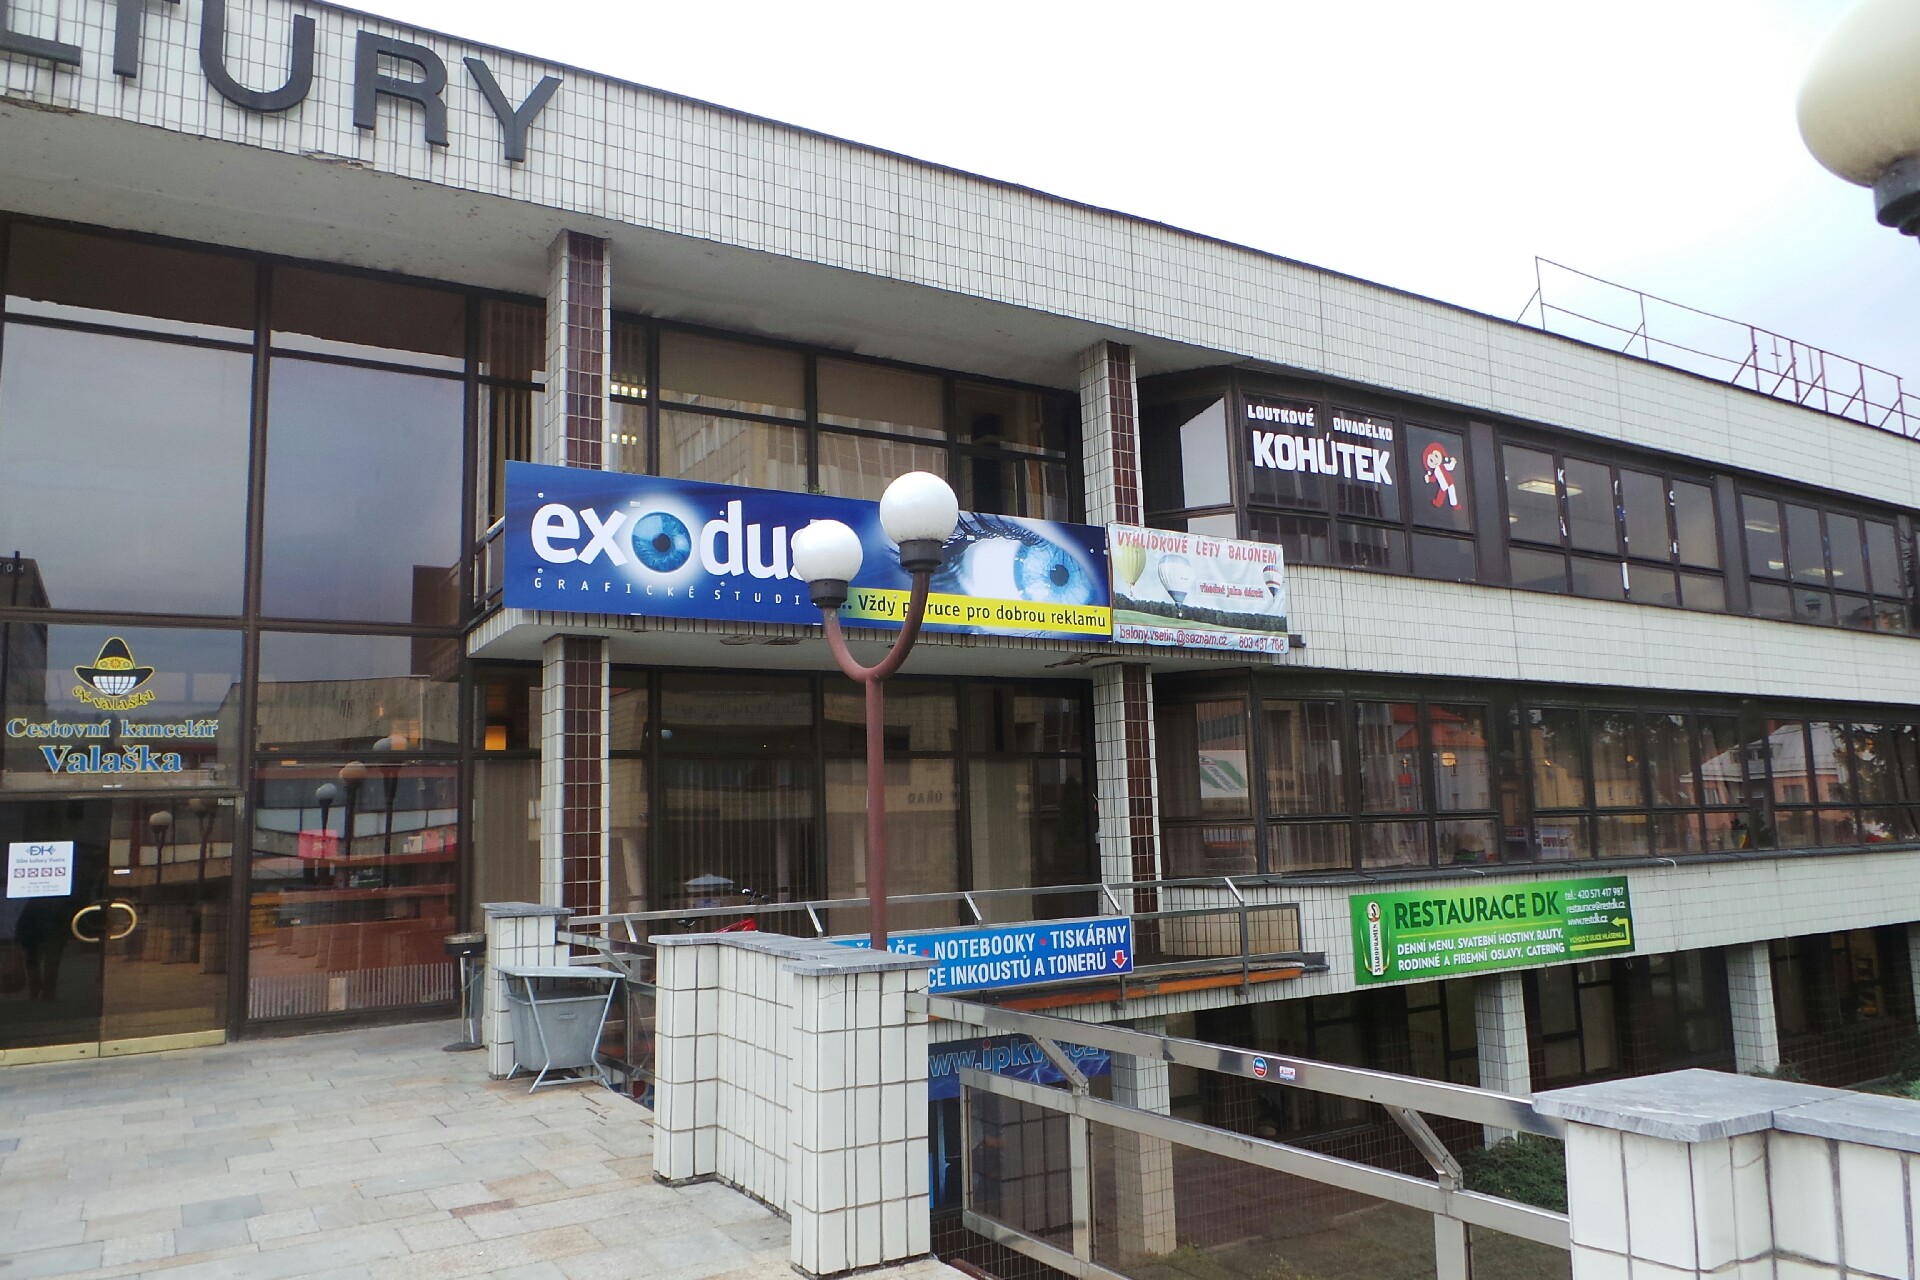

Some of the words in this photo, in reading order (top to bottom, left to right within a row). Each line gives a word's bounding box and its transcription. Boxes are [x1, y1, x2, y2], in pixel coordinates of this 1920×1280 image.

[1247, 404, 1315, 427] LOUTKOVÉ
[1333, 418, 1393, 441] DIVADÉLKO
[1252, 430, 1393, 485] KOHÚTEK
[1117, 530, 1188, 554] VYHLÍDKOVÉ
[1195, 542, 1221, 558] LETY
[1228, 545, 1277, 564] BALÓNEM
[534, 577, 695, 599] GRAFICKÉ
[714, 588, 817, 607] STUDI
[858, 594, 895, 616] Vždy
[903, 602, 961, 617] pruce
[967, 606, 990, 621] pro
[996, 605, 1046, 623] dobrou
[1051, 610, 1106, 628] reklamu
[6, 717, 111, 738] Cestovní
[119, 719, 219, 738] kancelář
[39, 744, 184, 774] Valaška
[1394, 893, 1527, 930] RESTAURACE
[1531, 891, 1561, 917] DK
[1578, 889, 1590, 899] 420
[1590, 888, 1601, 898] 571
[934, 933, 1036, 961] NOTEBOOKY
[1049, 925, 1127, 949] TISKÁRNY
[1397, 941, 1427, 956] DENNÍ
[1428, 939, 1456, 954] MENU,
[1457, 931, 1497, 949] SVATEBNÍ
[1537, 927, 1564, 942] RAUTY,
[1398, 955, 1441, 971] RODINNÉ
[1444, 955, 1451, 967] A
[1453, 949, 1488, 965] FIREMNÍ
[1490, 946, 1524, 961] OSLAVY,
[1527, 942, 1566, 957] CATERING
[950, 954, 1031, 986] INKOUSTŮ
[1034, 963, 1045, 976] A
[1048, 947, 1107, 975] TONERŮ
